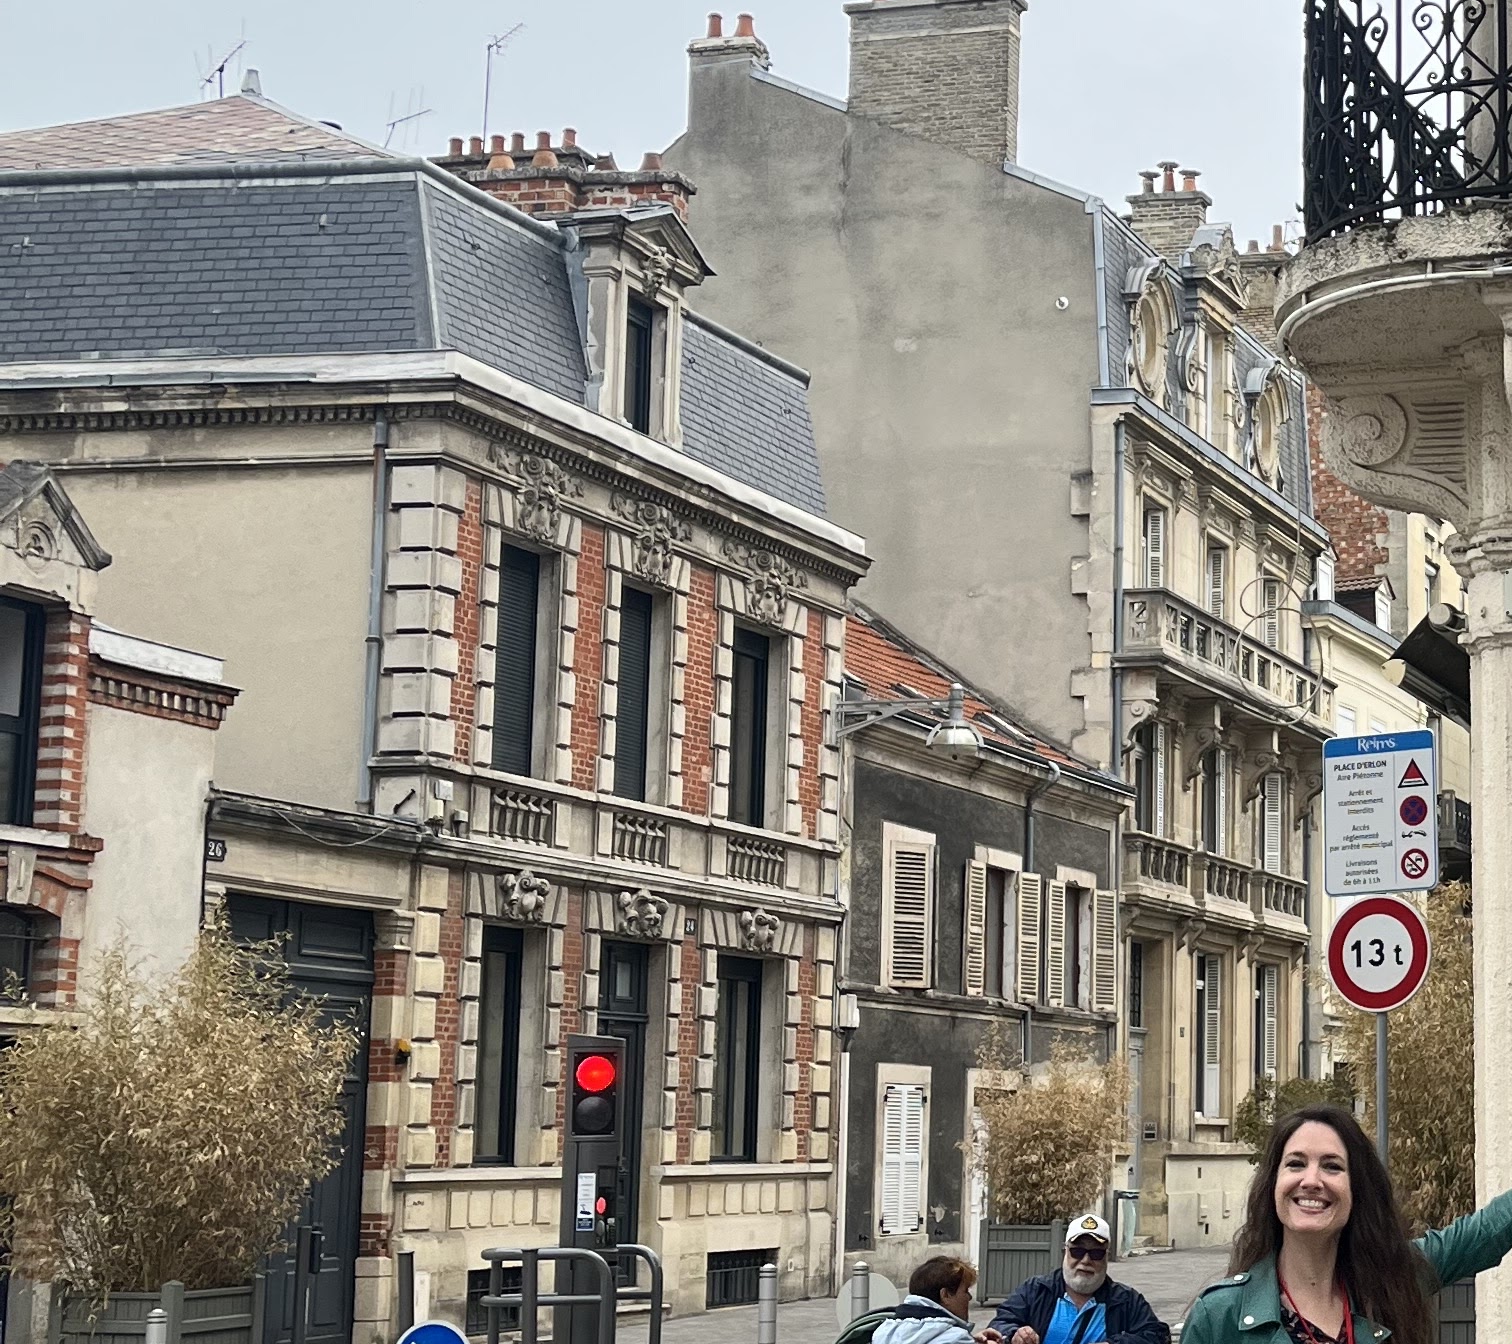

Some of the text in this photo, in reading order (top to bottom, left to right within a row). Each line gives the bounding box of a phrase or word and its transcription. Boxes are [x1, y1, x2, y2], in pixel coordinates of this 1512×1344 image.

[1357, 737, 1396, 752] Reims
[1333, 760, 1387, 772] PLACE D'ERLON
[208, 840, 223, 857] 26
[1350, 938, 1404, 968] 13 t
